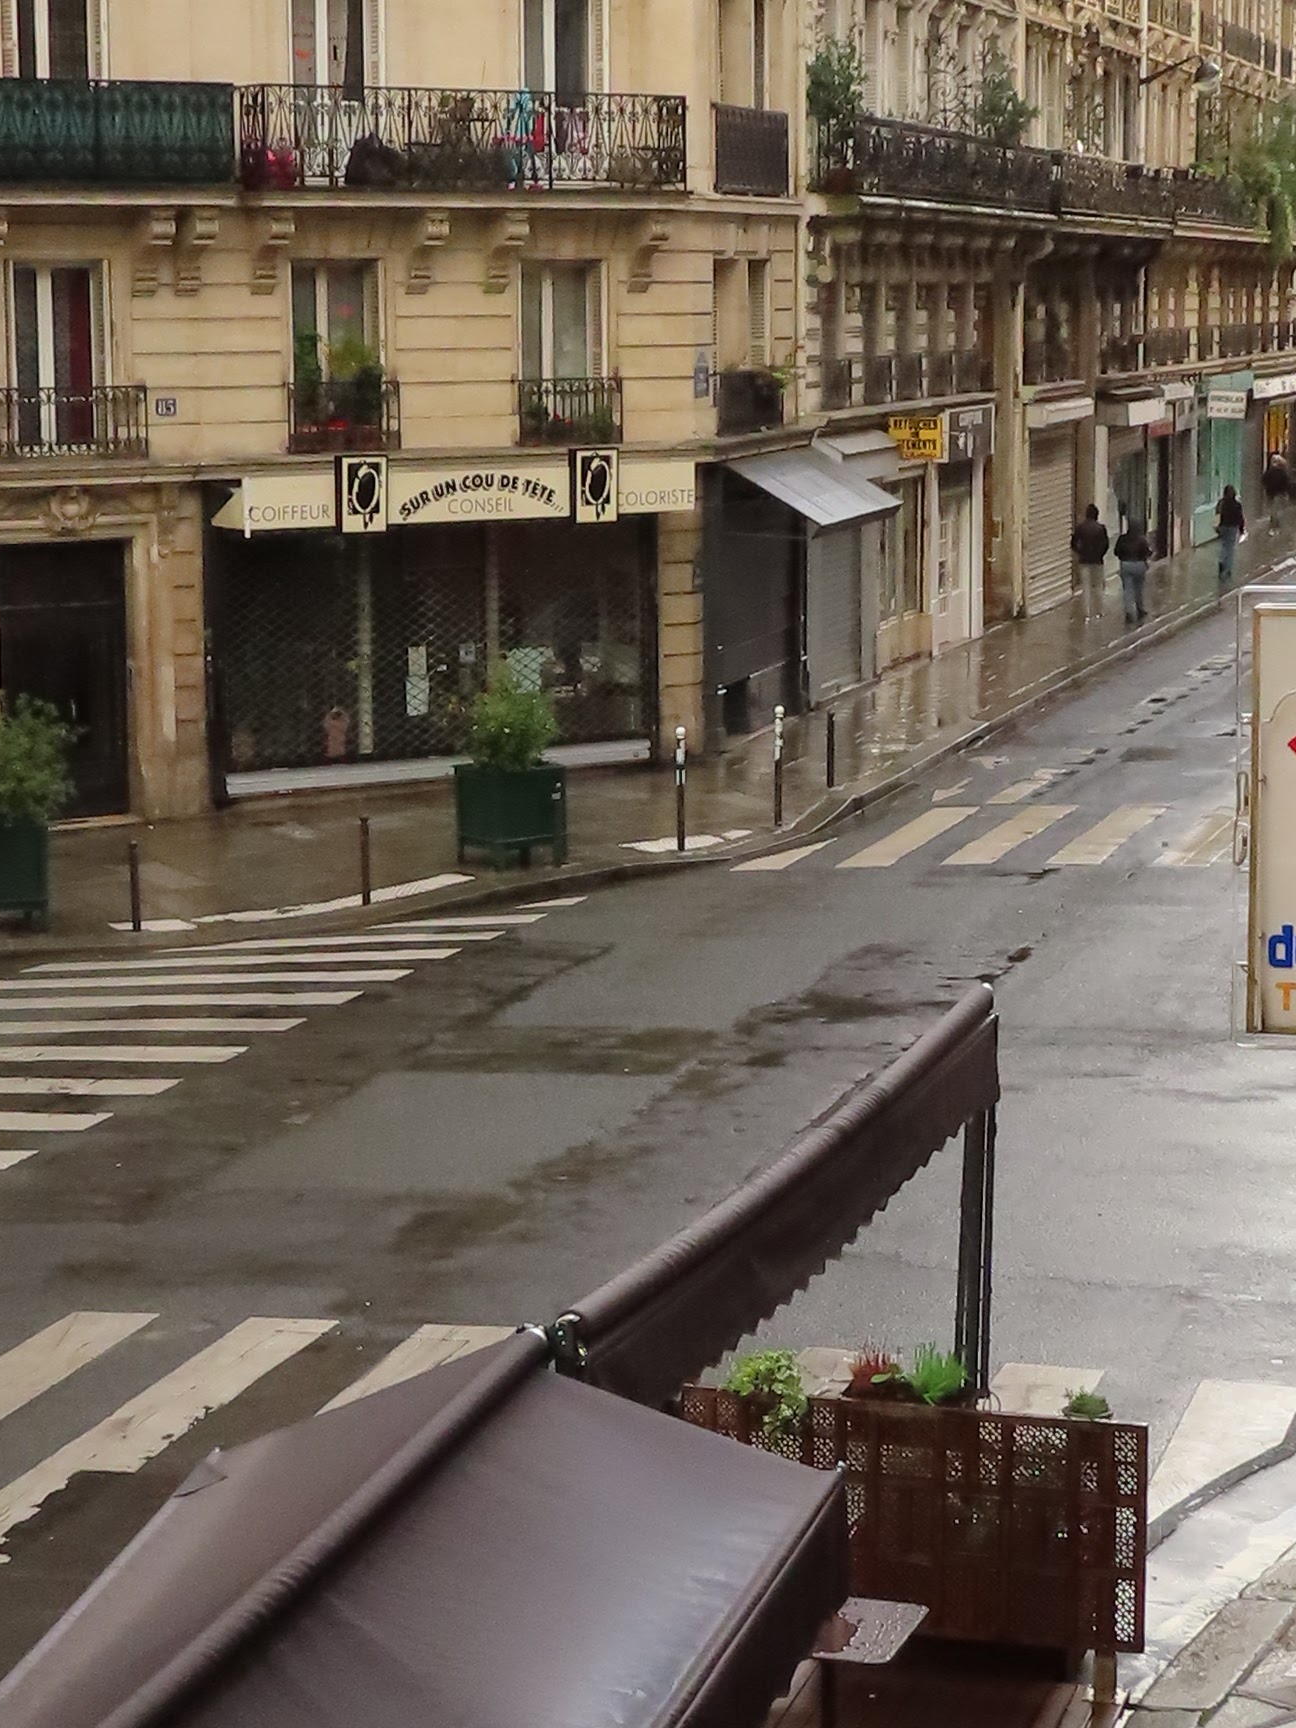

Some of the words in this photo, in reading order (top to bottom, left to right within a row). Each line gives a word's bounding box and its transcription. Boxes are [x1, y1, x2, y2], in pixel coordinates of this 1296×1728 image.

[399, 490, 431, 521] SUR
[432, 478, 458, 502] UN
[459, 473, 495, 492] COU
[498, 474, 520, 493] DE
[448, 497, 514, 514] CONSEIL
[618, 489, 695, 507] COLORISTE
[249, 504, 331, 522] COIFFEUR
